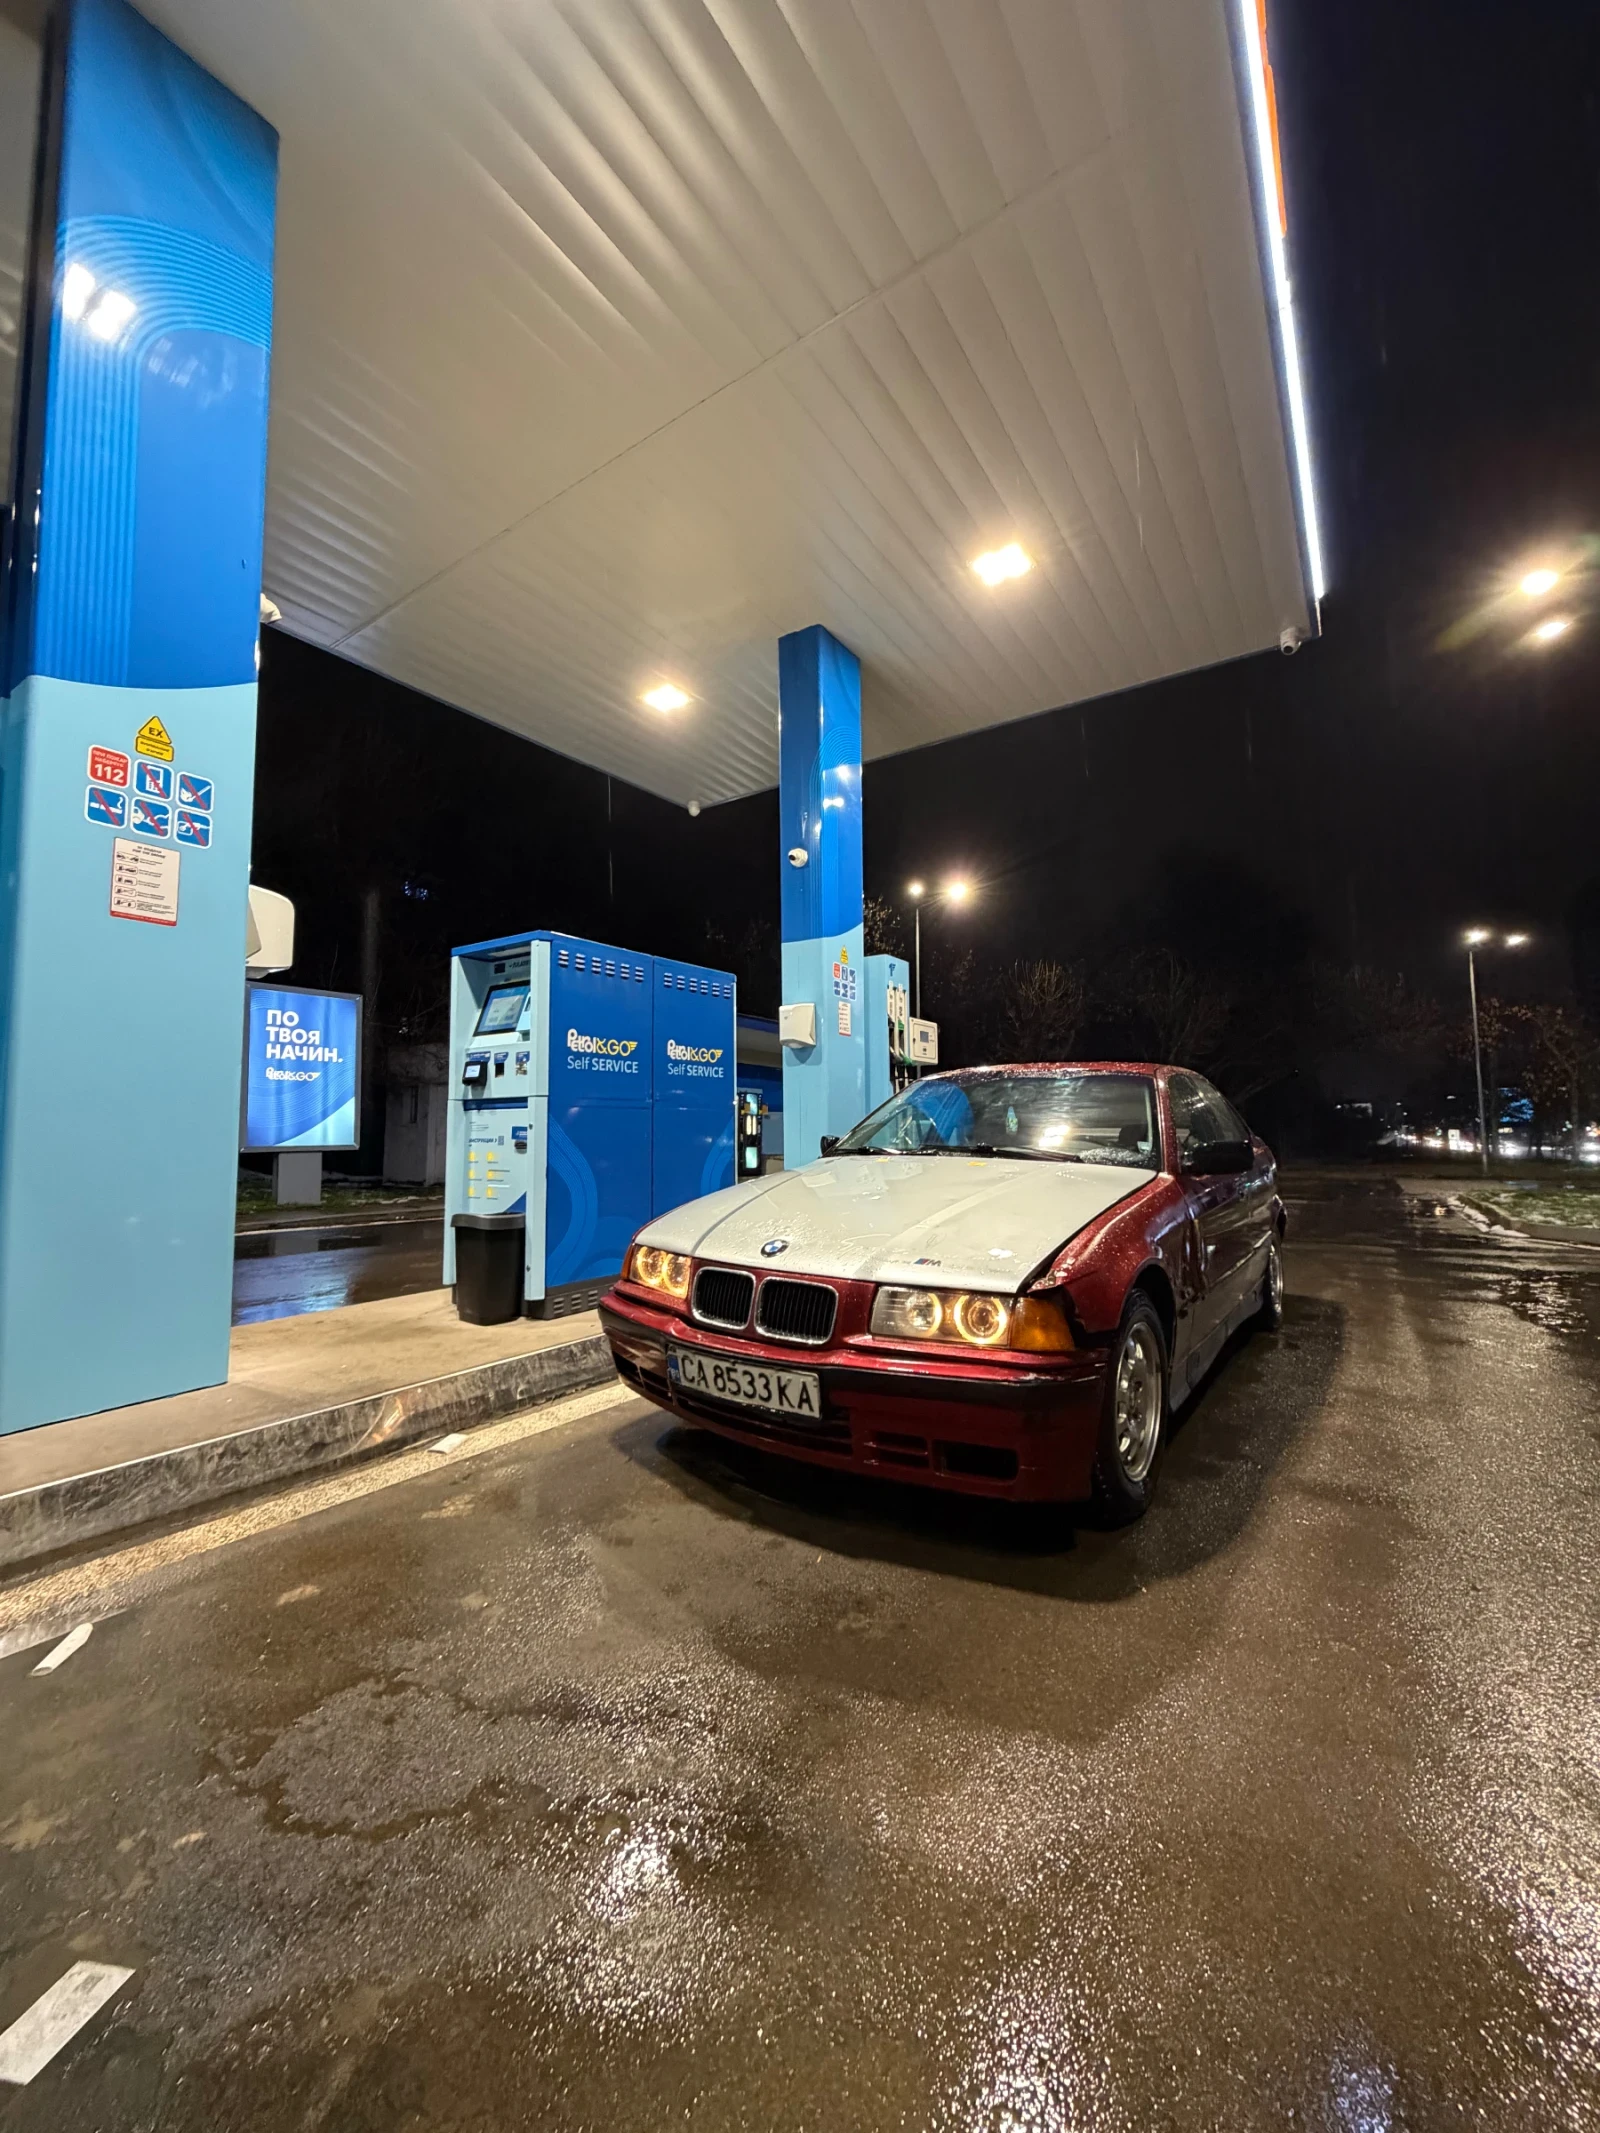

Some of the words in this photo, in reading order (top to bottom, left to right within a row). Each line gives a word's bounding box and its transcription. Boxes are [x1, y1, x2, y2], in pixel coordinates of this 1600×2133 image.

[148, 727, 163, 738] EX
[94, 763, 124, 783] 112
[266, 1009, 299, 1027] ПО
[265, 1027, 320, 1045] ТВОЯ
[265, 1044, 344, 1063] НАЧИН.
[567, 1055, 590, 1070] Self
[591, 1057, 638, 1073] SERVICE
[667, 1062, 686, 1075] Self
[687, 1065, 724, 1078] SERVICE
[681, 1354, 710, 1389] CA
[713, 1364, 772, 1403] 8533
[777, 1375, 815, 1413] KA
